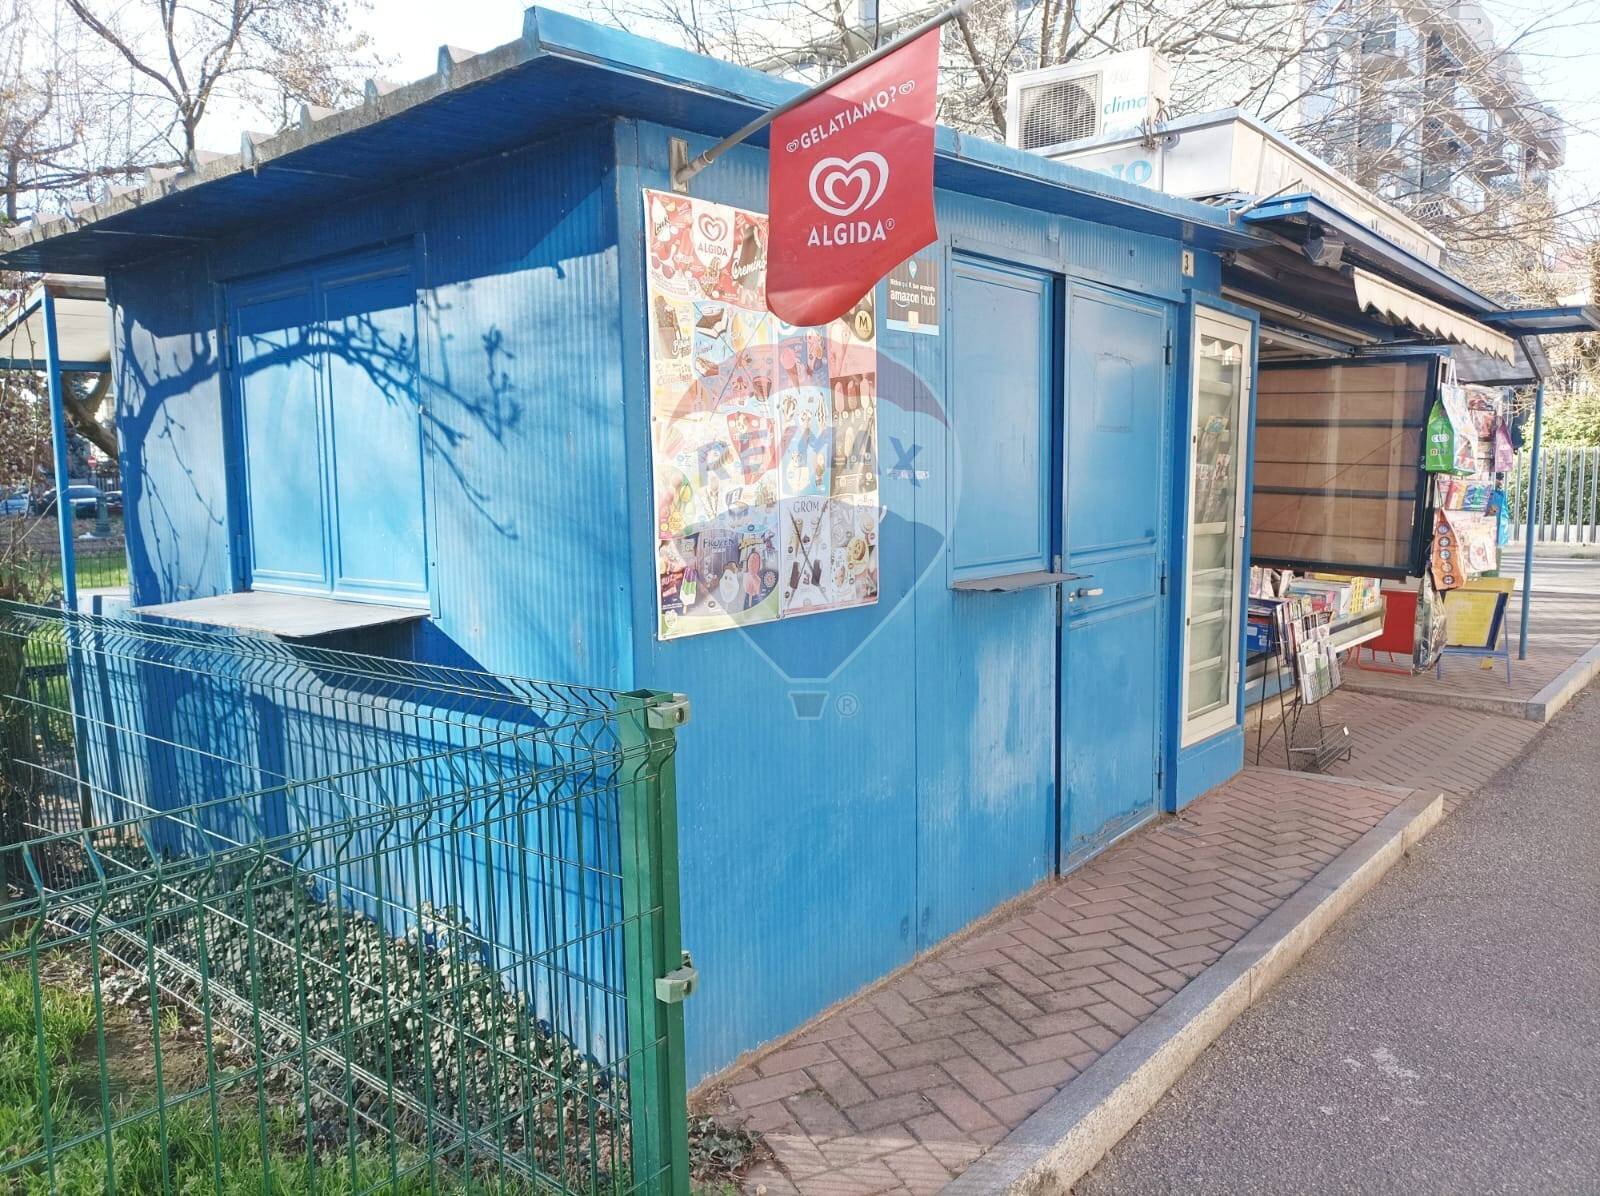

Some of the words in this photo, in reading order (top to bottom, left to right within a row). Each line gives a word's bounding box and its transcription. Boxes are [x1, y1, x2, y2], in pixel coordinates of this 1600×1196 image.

[800, 86, 897, 149] GELATIAMO?
[698, 242, 728, 257] ALGIDA
[890, 289, 920, 304] amazon
[920, 291, 936, 306] hub
[859, 315, 868, 329] M
[793, 500, 819, 513] GROM
